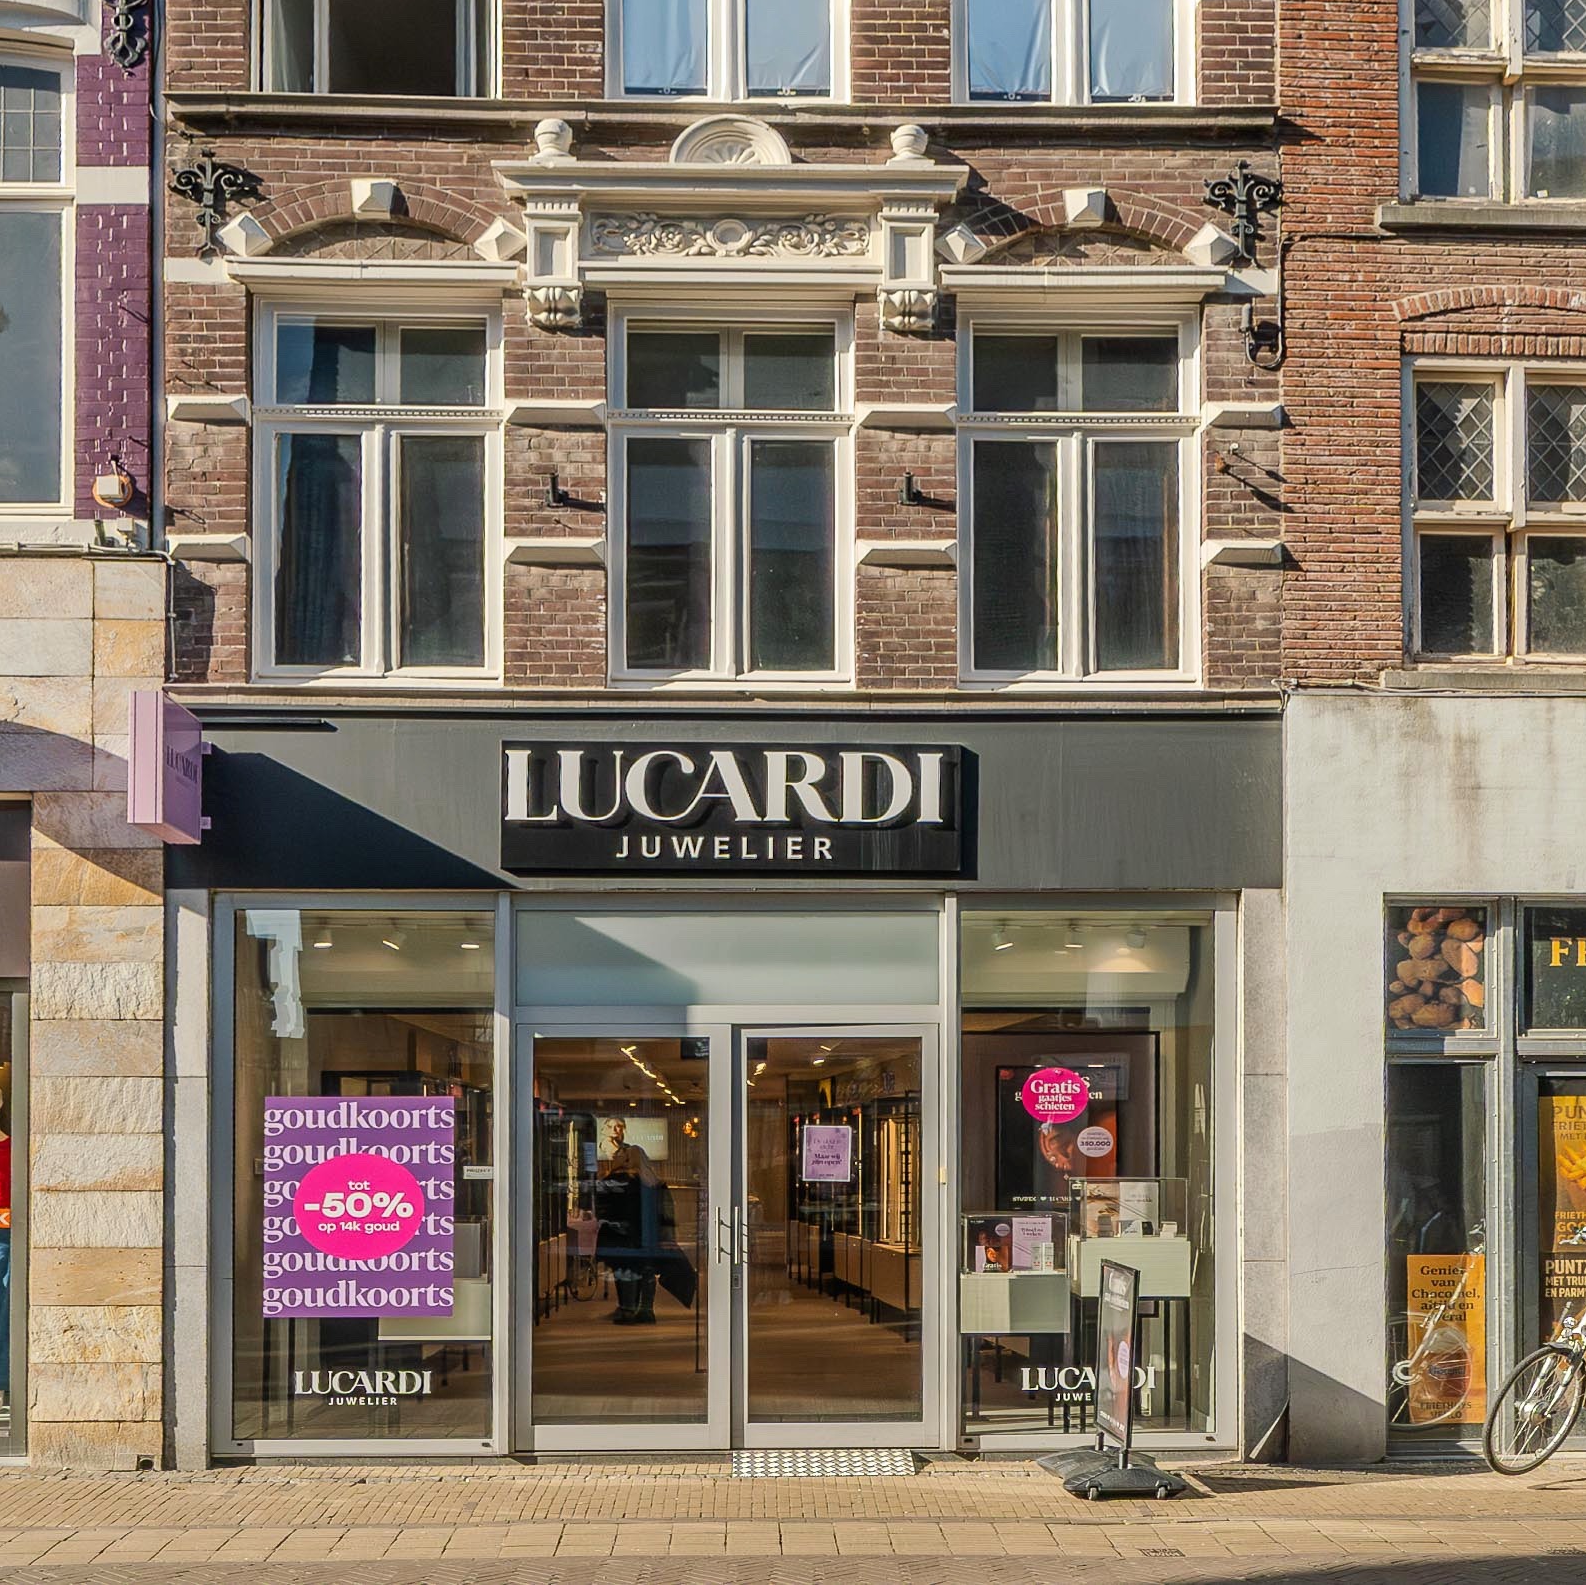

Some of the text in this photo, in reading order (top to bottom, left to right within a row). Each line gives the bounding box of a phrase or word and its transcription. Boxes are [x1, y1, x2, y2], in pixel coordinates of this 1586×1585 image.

[504, 749, 943, 823] LUCARDI
[616, 836, 833, 860] JUWELIER
[1030, 1079, 1081, 1094] Gratis
[1034, 1102, 1075, 1111] schieten
[1038, 1095, 1072, 1104] gaatjes
[263, 1101, 454, 1136] goudkoorts
[348, 1180, 370, 1191] tot
[304, 1192, 414, 1218] -50%
[318, 1221, 400, 1234] op 14k goud
[1431, 1279, 1455, 1287] van
[263, 1280, 454, 1315] goudkoorts
[1458, 1302, 1474, 1310] en
[294, 1370, 432, 1394] LUCARDI
[1021, 1366, 1156, 1391] LUCADI
[328, 1396, 398, 1406] JUWELIER
[1055, 1392, 1092, 1402] JUWE
